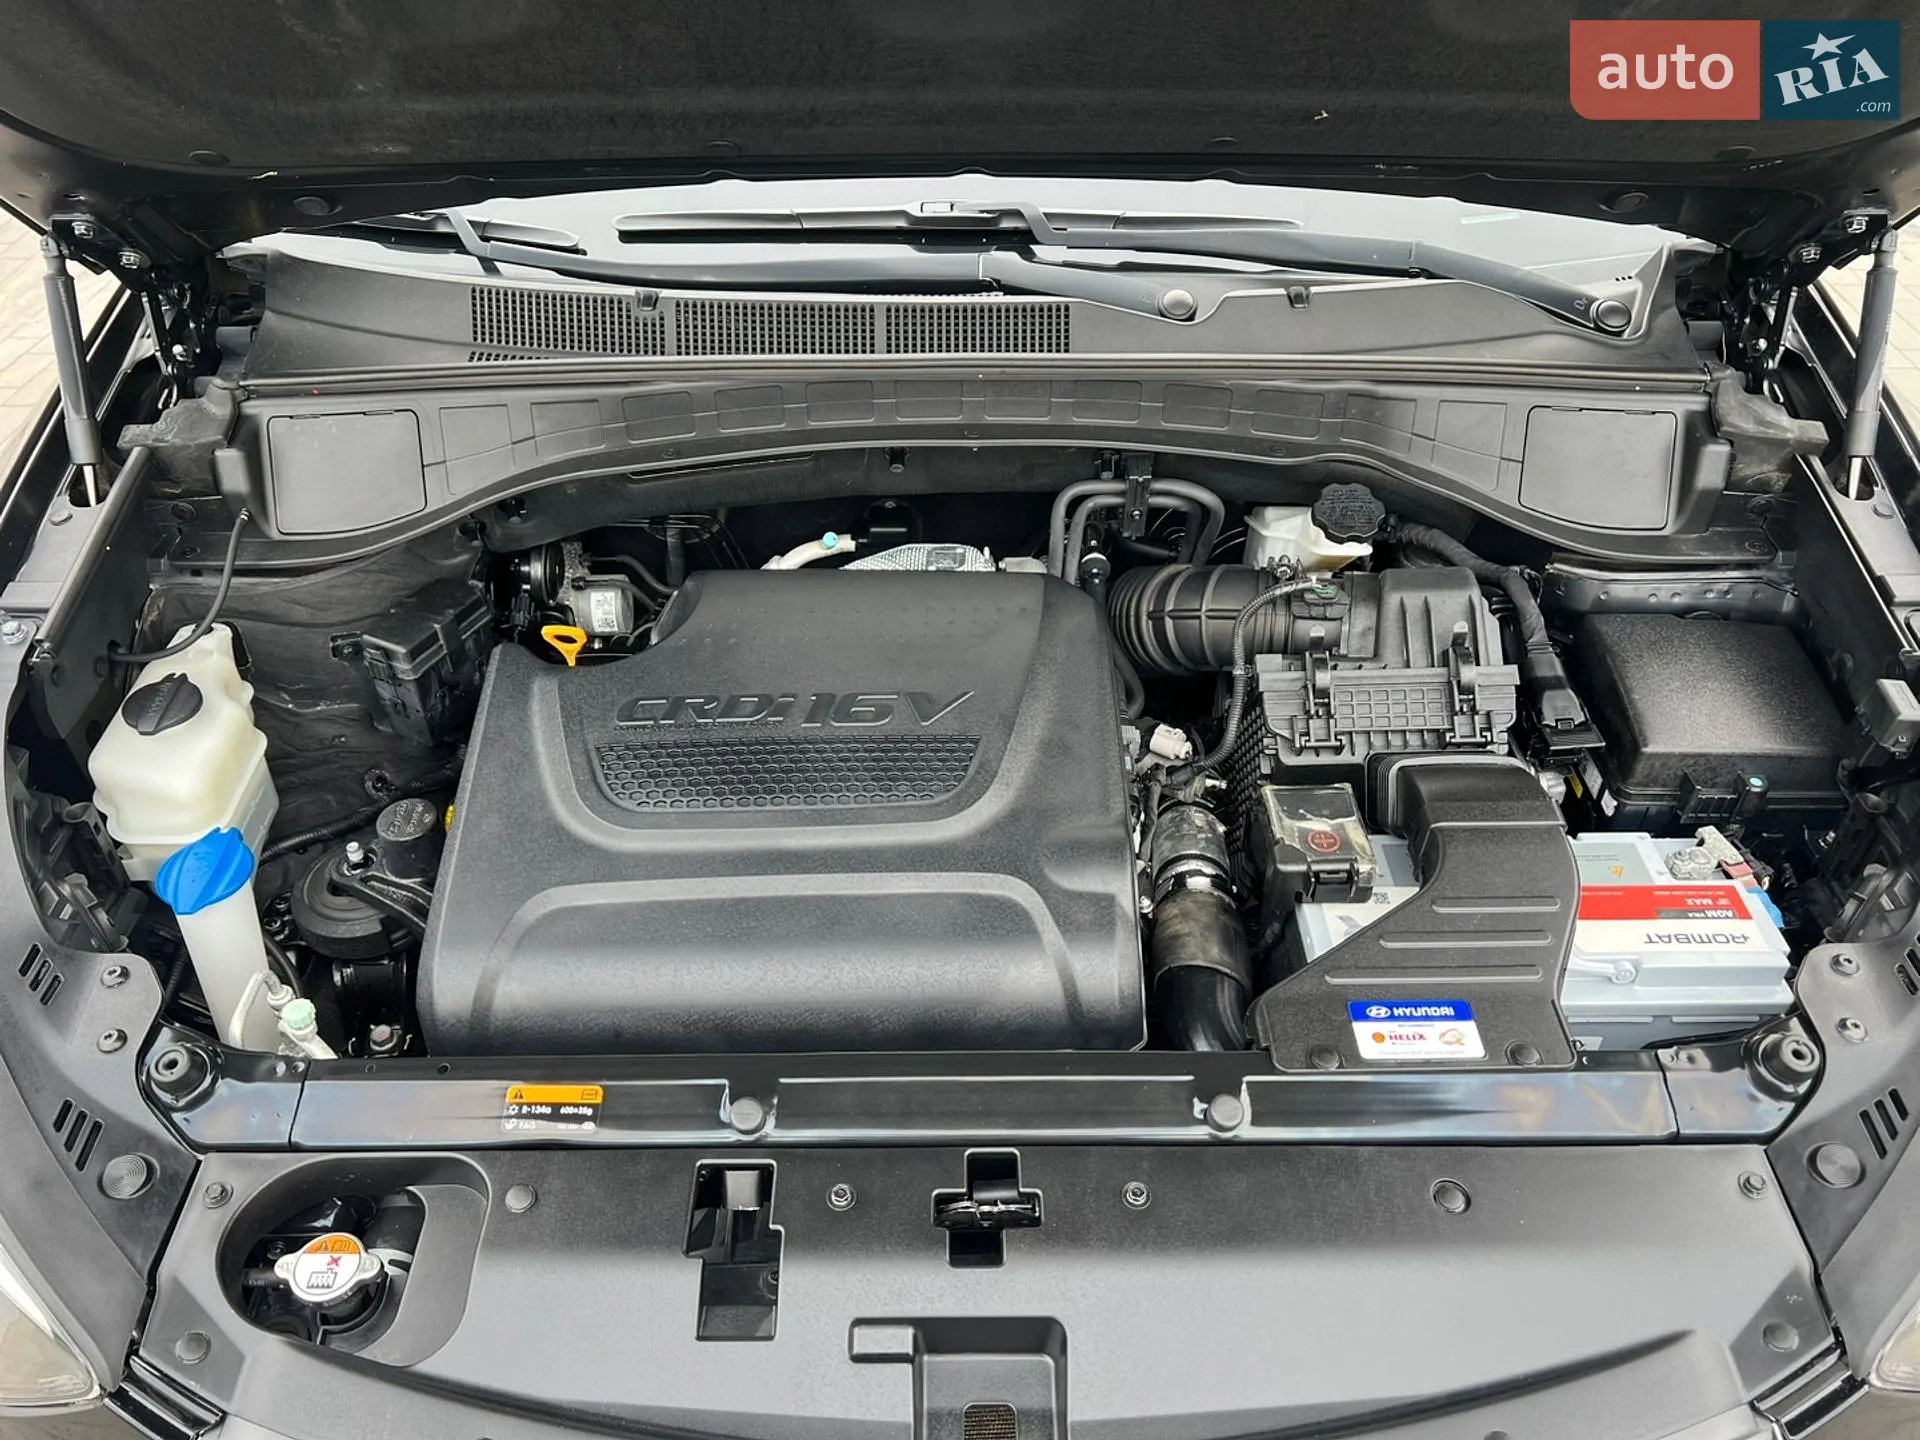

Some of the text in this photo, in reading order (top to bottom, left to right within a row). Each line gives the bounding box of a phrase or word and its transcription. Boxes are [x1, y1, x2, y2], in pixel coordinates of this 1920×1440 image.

[1643, 933, 1751, 945] ROMBAT
[1393, 1006, 1455, 1017] HYUNDAI
[1388, 1032, 1427, 1041] HELIX
[521, 1105, 552, 1114] R-134a
